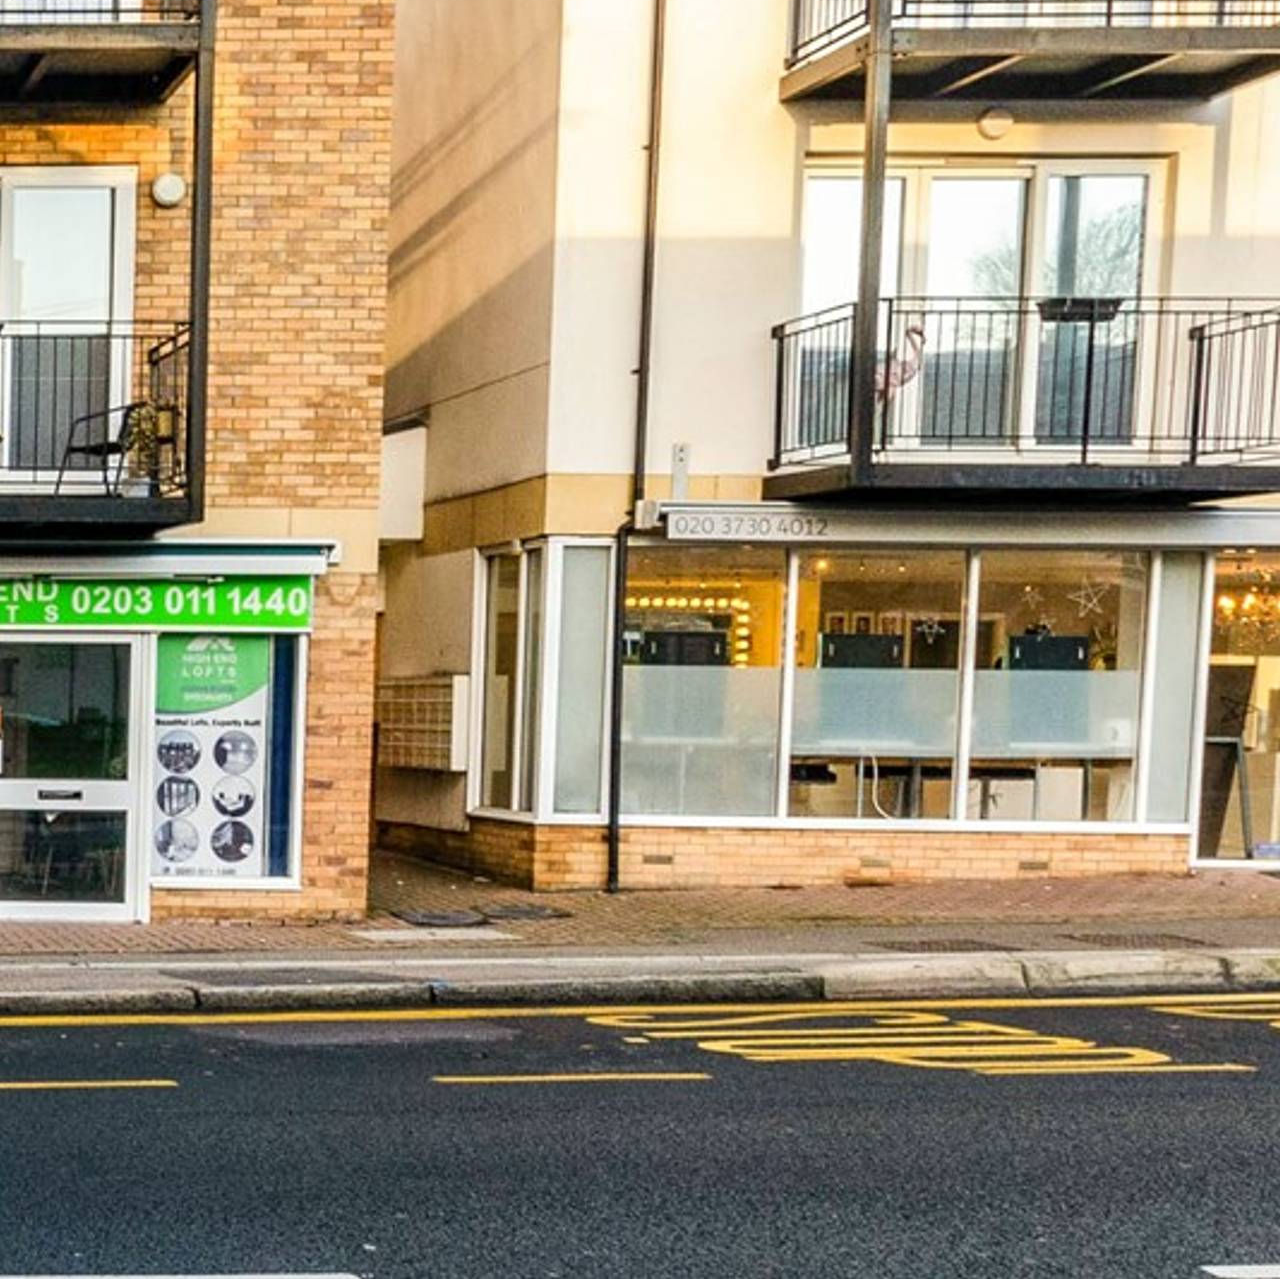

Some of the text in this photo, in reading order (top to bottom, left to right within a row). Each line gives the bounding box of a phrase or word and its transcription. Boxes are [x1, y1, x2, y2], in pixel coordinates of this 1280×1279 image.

[675, 516, 828, 537] 020 3730 4012
[71, 586, 308, 617] 0203 011 1440
